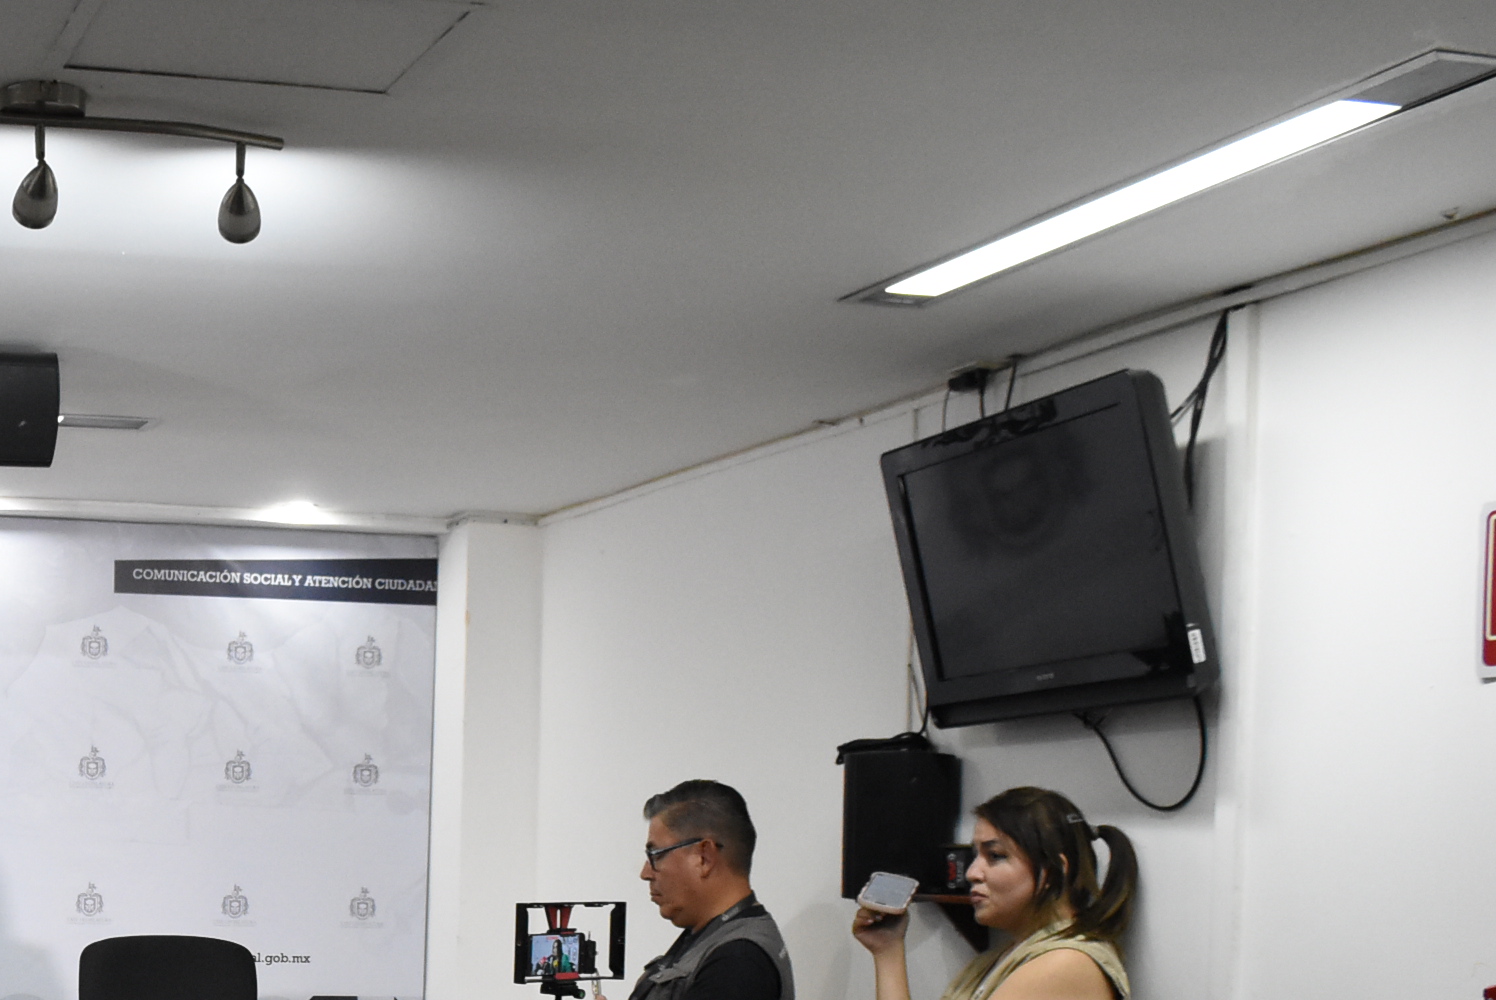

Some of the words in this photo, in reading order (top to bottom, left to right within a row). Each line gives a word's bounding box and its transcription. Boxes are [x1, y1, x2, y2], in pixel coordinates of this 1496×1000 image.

[132, 568, 241, 583] COMUNICACIÓN
[243, 572, 292, 586] SOCIAL
[291, 574, 302, 586] Y
[304, 575, 372, 589] ATENCIÓN
